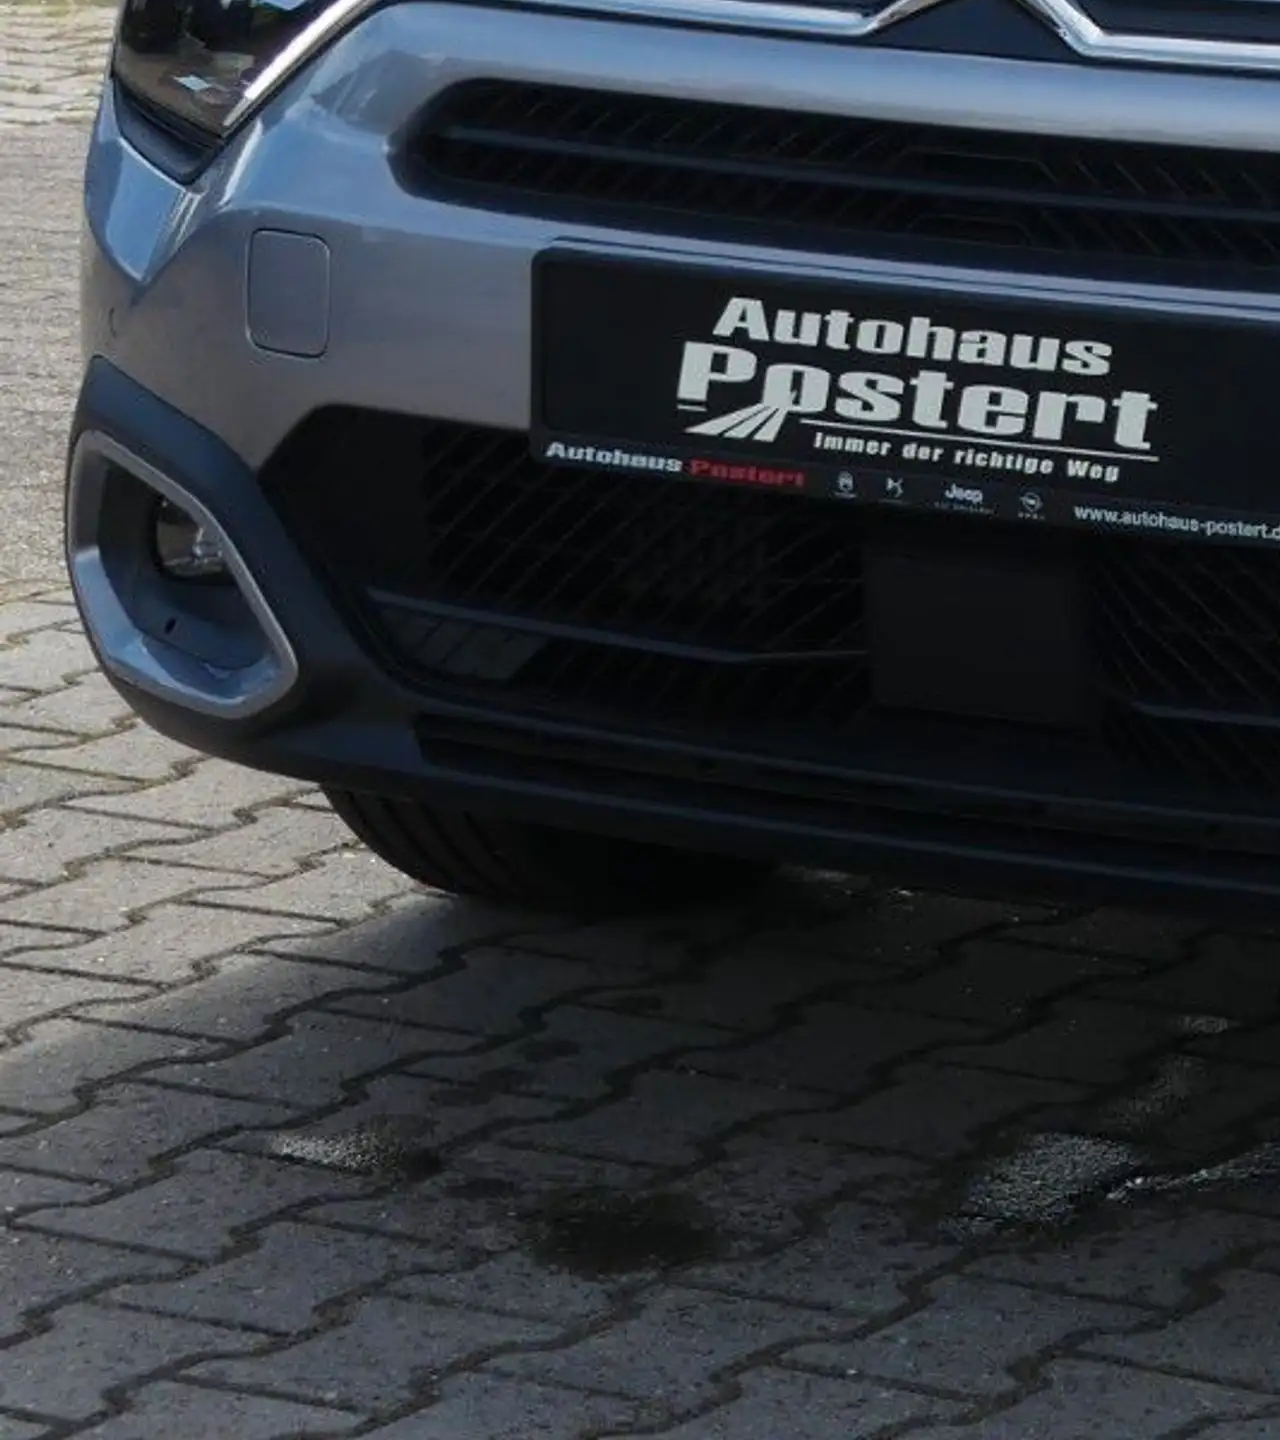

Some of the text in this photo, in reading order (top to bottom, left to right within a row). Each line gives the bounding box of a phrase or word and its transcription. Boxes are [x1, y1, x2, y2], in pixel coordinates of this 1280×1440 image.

[712, 296, 1113, 376] Autohaus
[676, 340, 1160, 450] Postert
[545, 440, 806, 487] Autohaus Postert
[813, 431, 1120, 482] Immer der richtige Weg
[944, 482, 984, 505] Jeep
